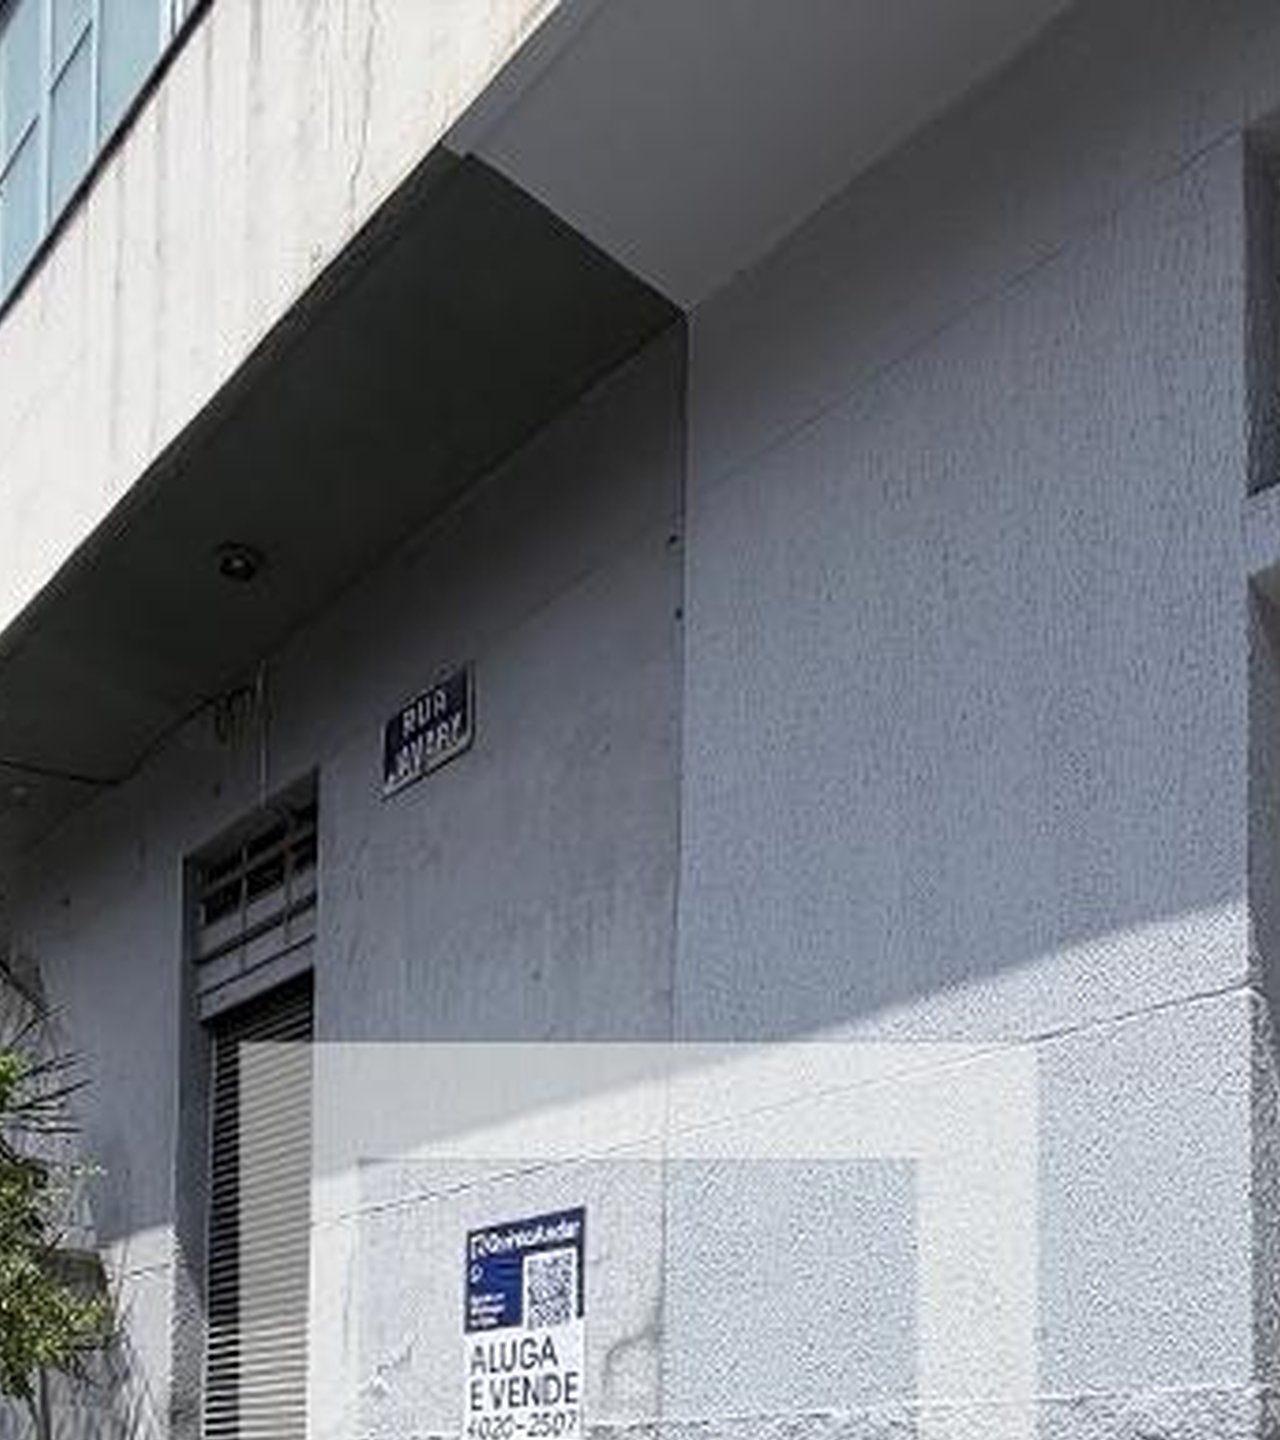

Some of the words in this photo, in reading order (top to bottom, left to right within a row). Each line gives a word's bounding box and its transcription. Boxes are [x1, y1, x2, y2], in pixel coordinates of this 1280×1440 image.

[402, 688, 447, 738] RUA
[470, 1336, 559, 1375] ALUGA
[470, 1379, 484, 1411] E
[489, 1371, 579, 1410] VENDE
